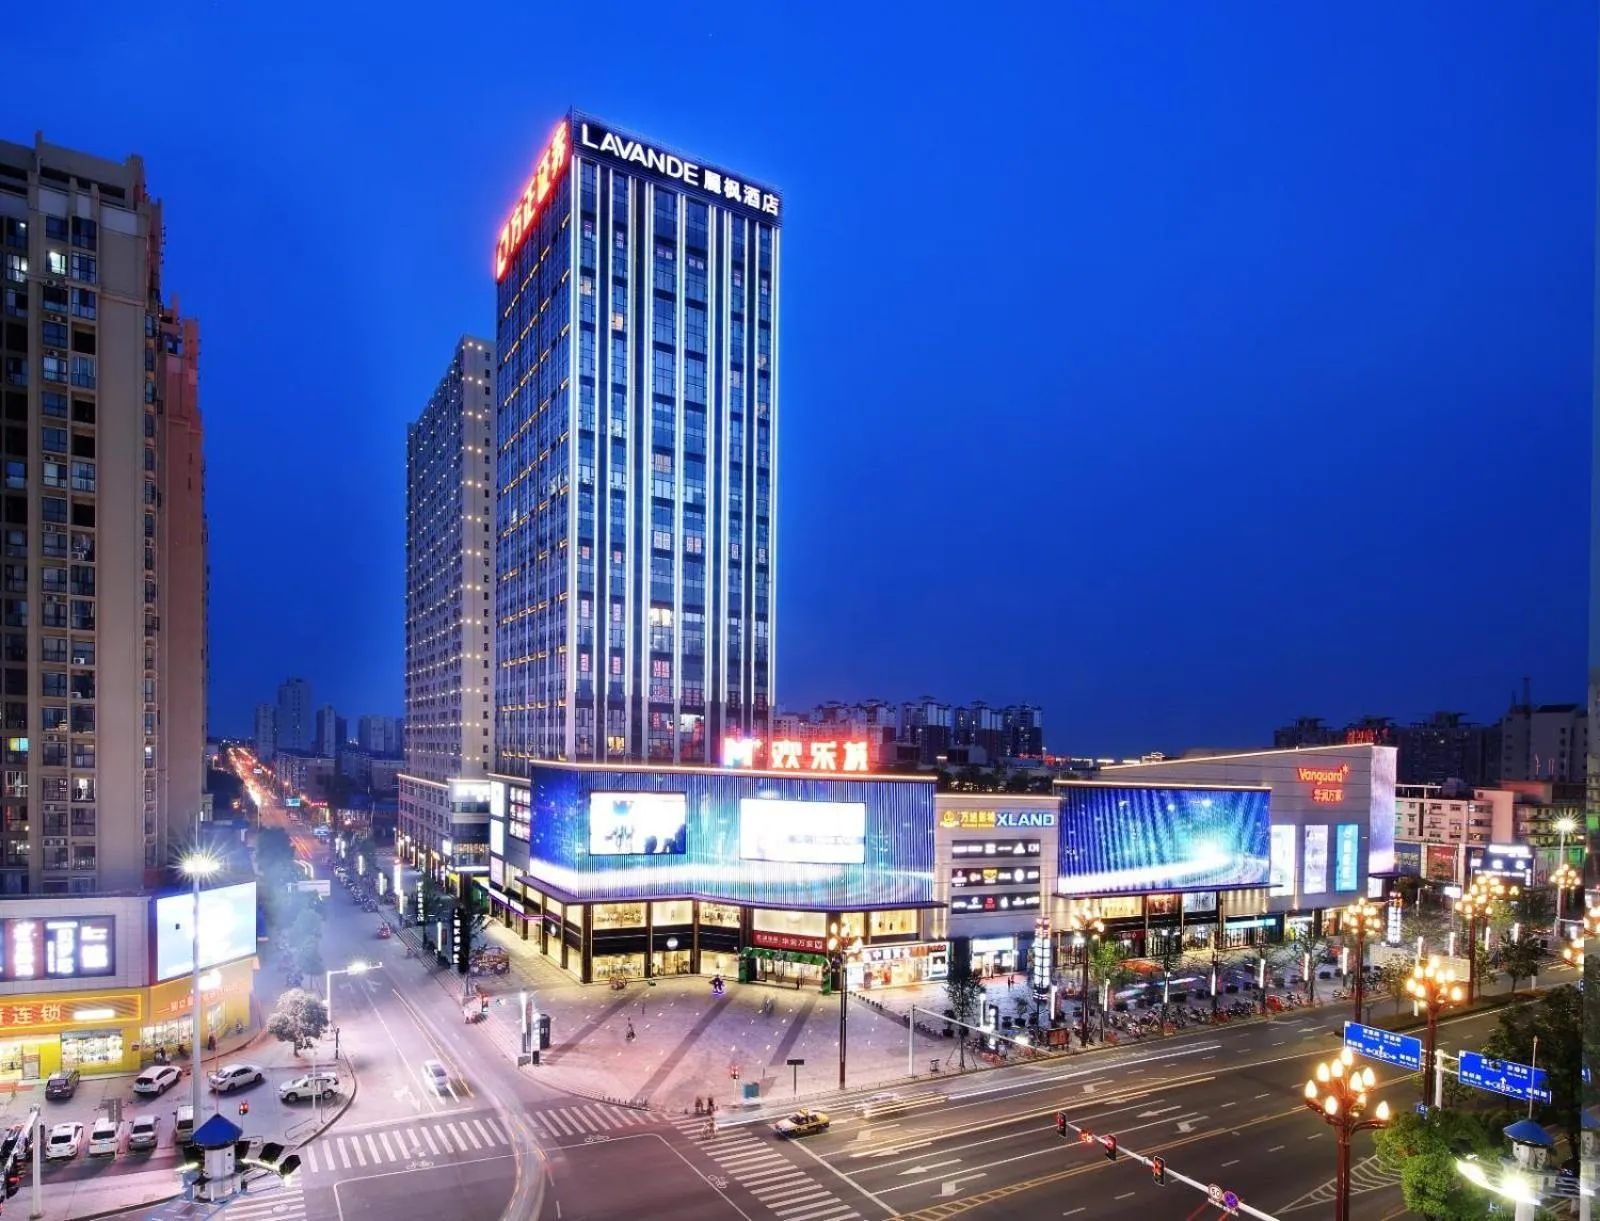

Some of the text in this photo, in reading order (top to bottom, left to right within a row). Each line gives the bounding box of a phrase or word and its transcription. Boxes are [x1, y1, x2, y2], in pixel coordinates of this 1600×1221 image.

[582, 123, 699, 187] LAVANDE
[1299, 767, 1343, 786] Vanguard
[996, 813, 1055, 826] XLAND
[0, 1003, 62, 1025] 连锁
